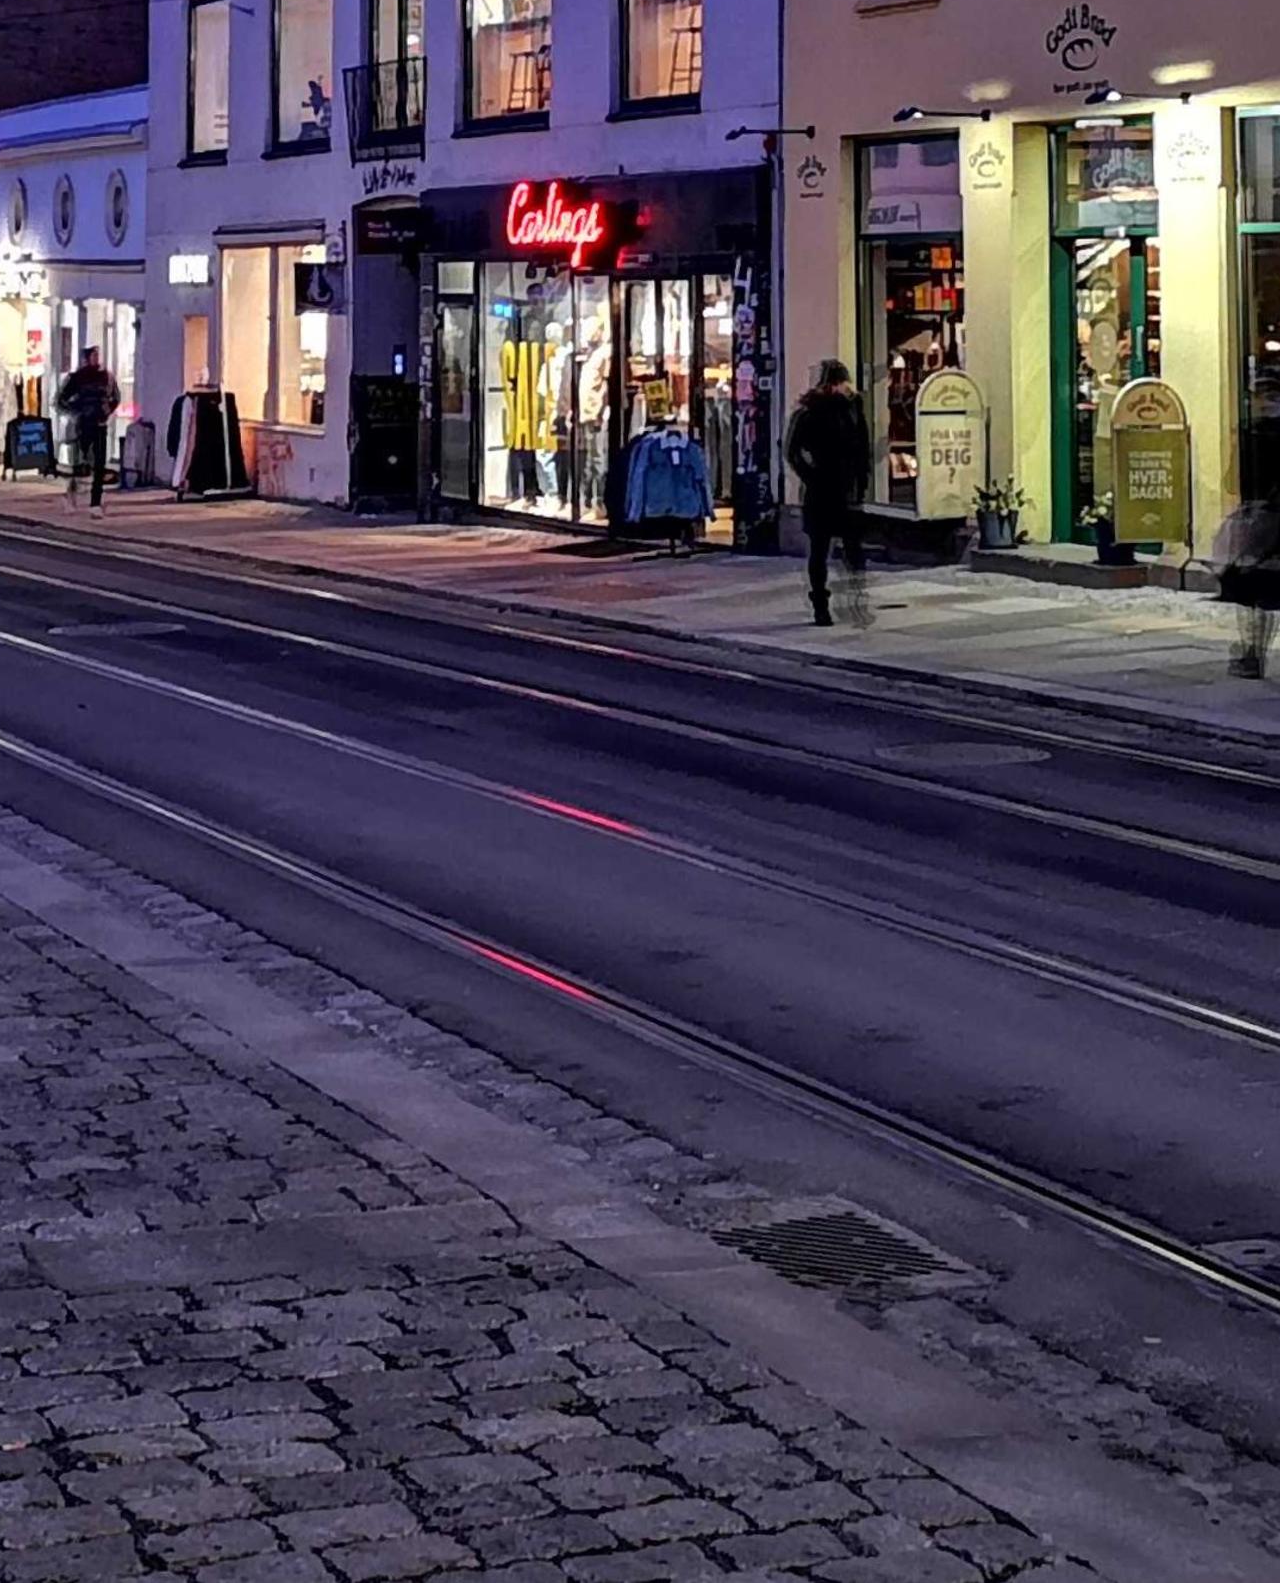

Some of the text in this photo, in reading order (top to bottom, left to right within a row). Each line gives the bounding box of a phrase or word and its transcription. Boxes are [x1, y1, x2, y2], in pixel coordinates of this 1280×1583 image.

[506, 181, 604, 268] Carlings
[930, 448, 972, 466] DEIG
[948, 467, 956, 485] ?
[1128, 469, 1173, 485] HVER-
[1128, 485, 1174, 501] DAGEN
